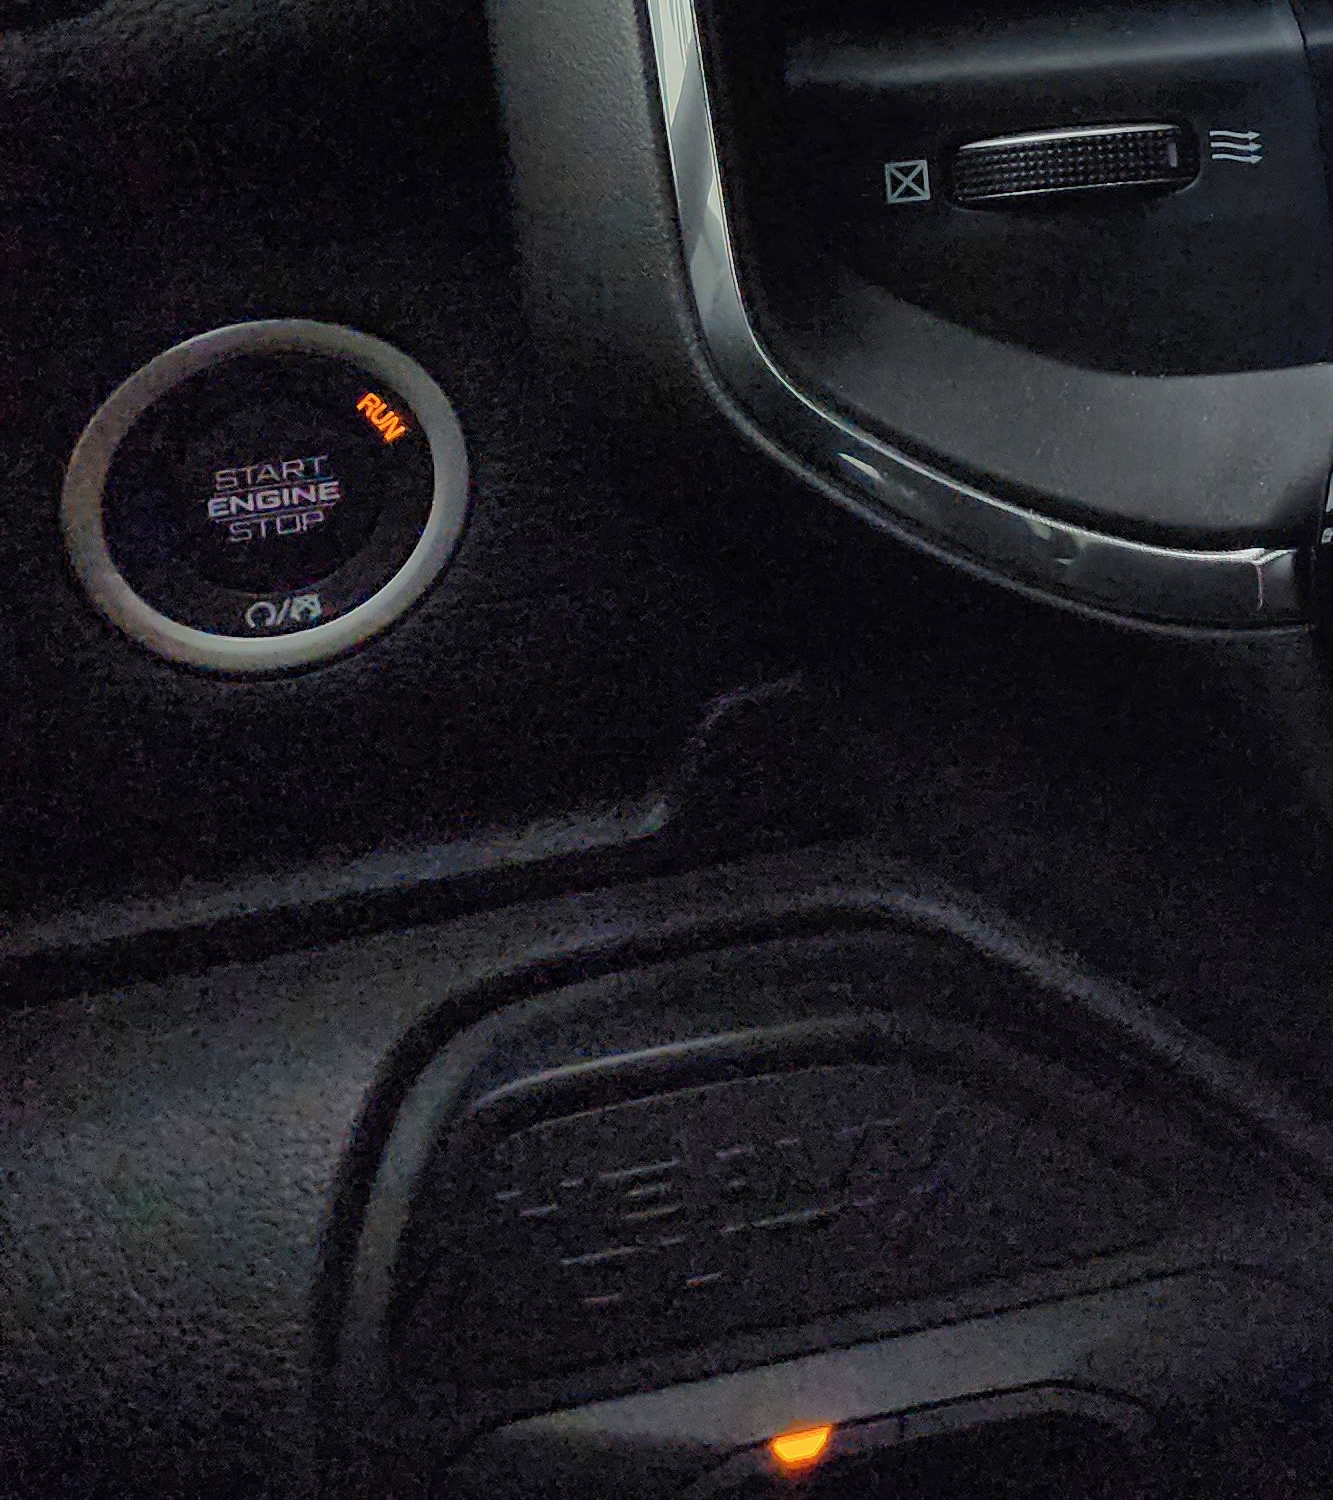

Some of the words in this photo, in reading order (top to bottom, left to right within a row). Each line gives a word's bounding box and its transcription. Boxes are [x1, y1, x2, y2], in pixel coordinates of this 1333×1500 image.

[356, 392, 406, 445] RUN
[215, 455, 329, 491] START
[207, 480, 341, 518] ENGINE
[228, 510, 325, 542] STOP
